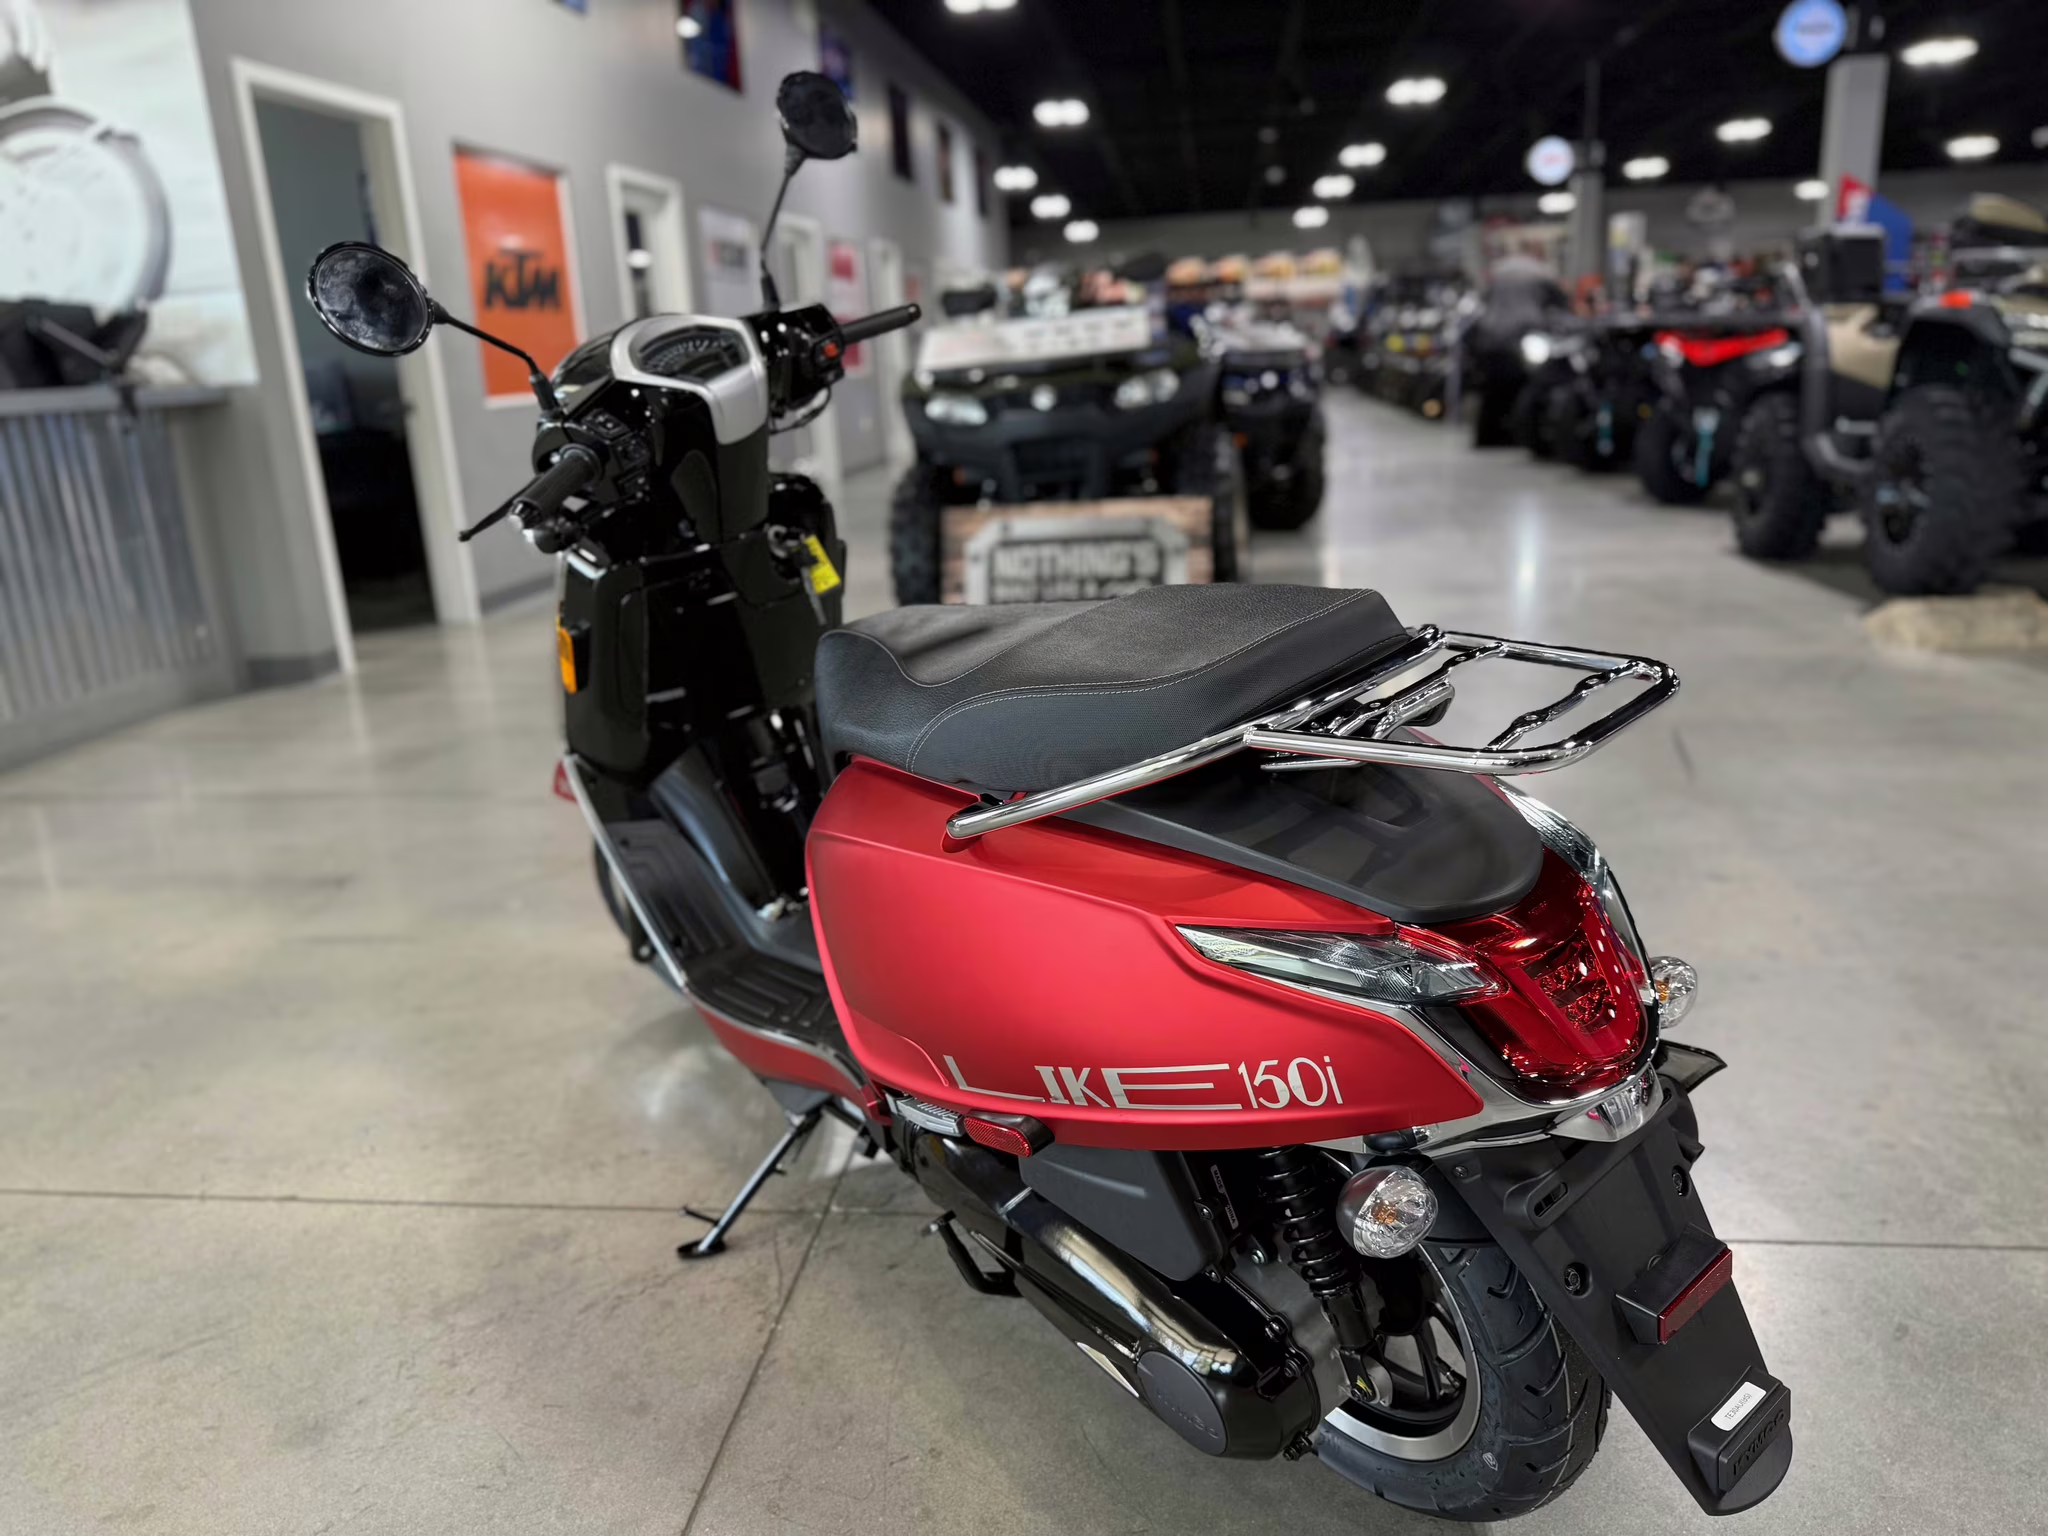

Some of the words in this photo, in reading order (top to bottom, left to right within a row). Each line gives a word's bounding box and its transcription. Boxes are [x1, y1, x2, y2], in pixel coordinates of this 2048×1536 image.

[485, 249, 561, 311] KTM
[993, 541, 1160, 579] NOTHING'S
[943, 1055, 1243, 1110] LIKE
[1238, 1055, 1343, 1109] 150i
